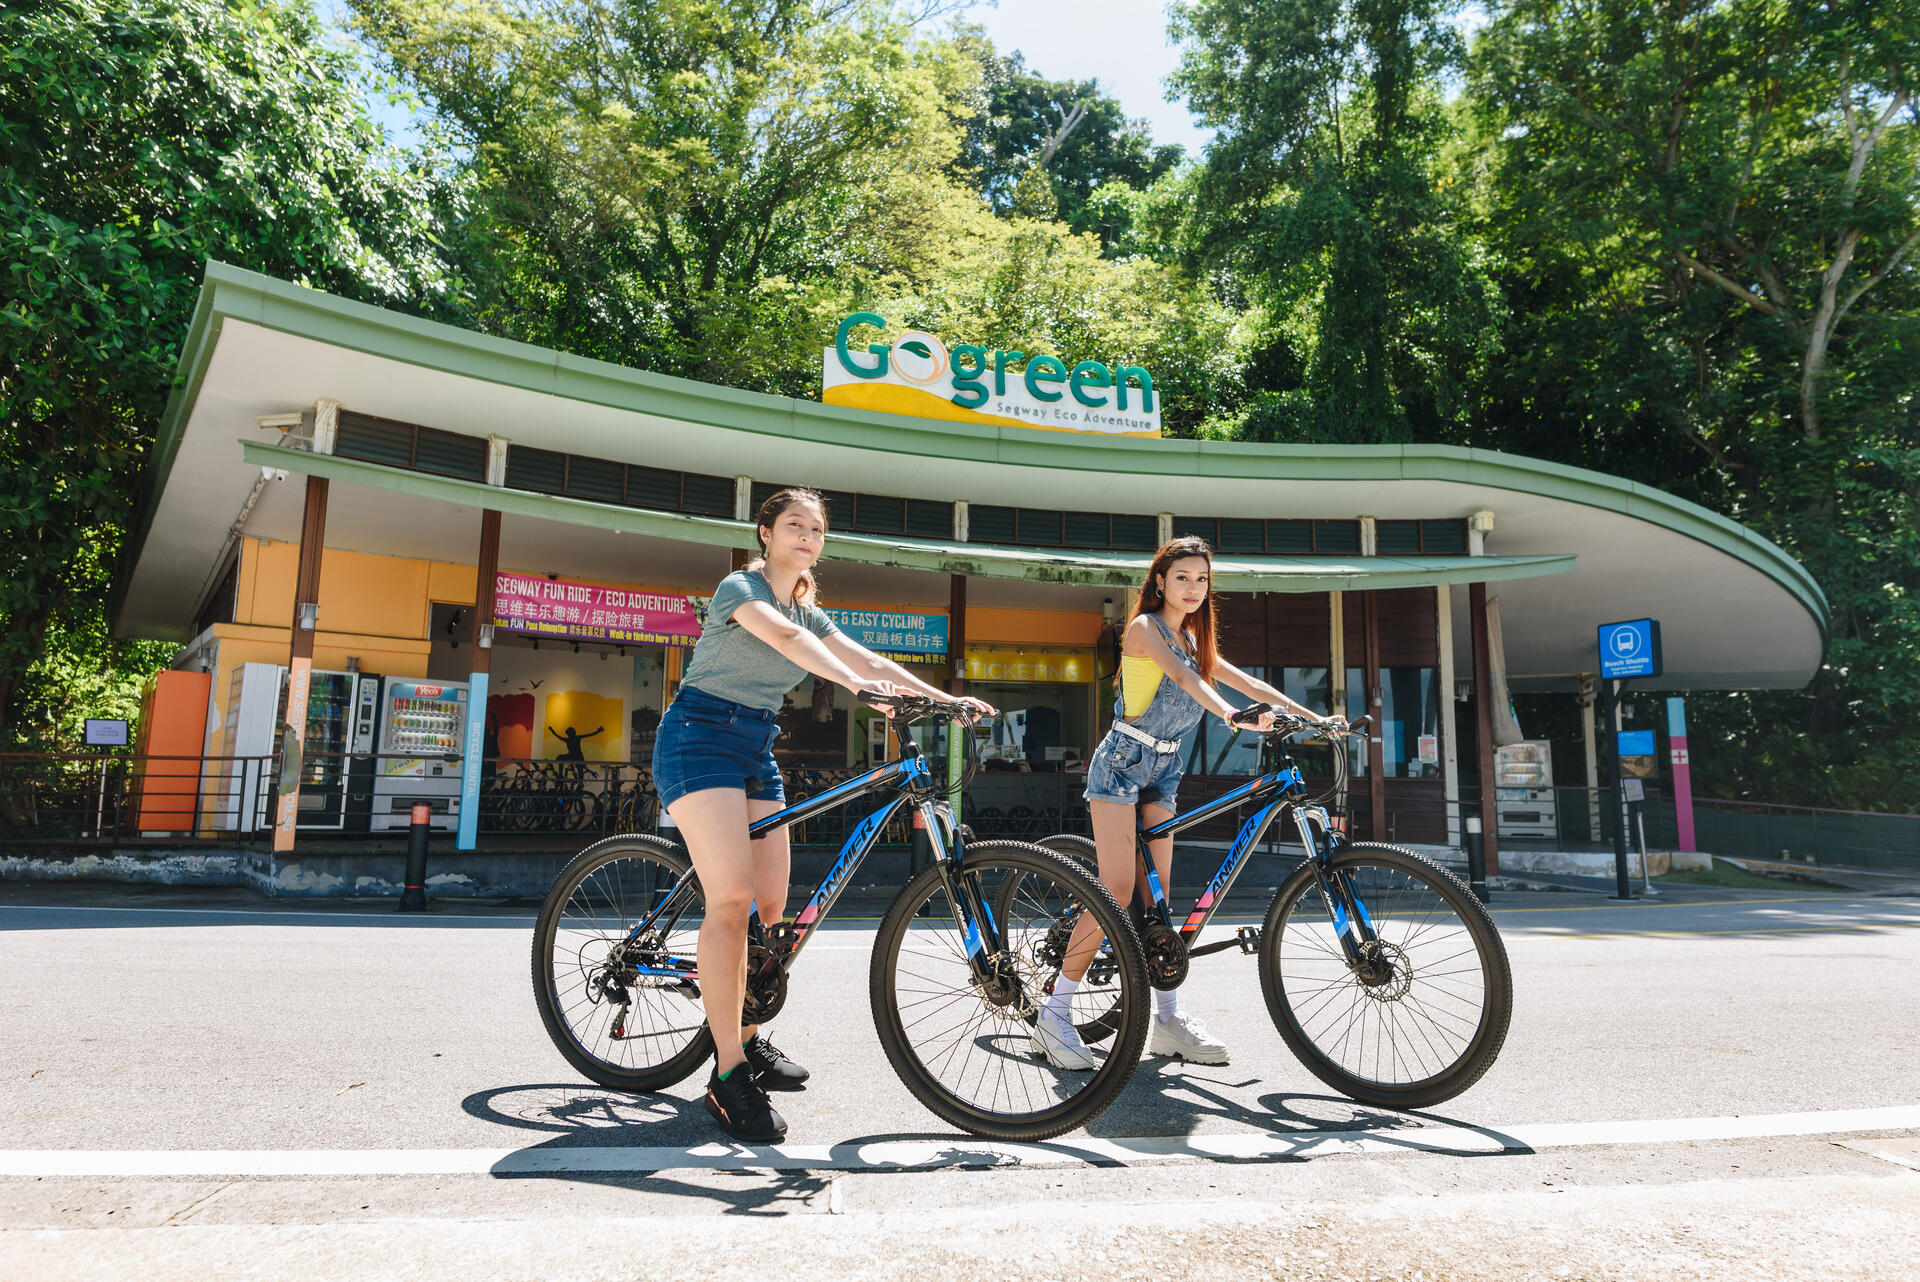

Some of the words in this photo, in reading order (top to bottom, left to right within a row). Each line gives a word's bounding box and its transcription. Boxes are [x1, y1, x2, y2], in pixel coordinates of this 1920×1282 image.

[996, 402, 1047, 419] Segway
[1054, 409, 1078, 421] Eco
[1084, 411, 1152, 429] Adventure
[496, 576, 541, 598] SEGWAY
[544, 582, 565, 600] FUN
[567, 586, 592, 603] RIDE
[596, 590, 603, 604] /
[605, 590, 625, 607] ECO
[628, 593, 686, 614] ADVENTURE
[494, 598, 580, 624] 思维车乐趣游
[591, 608, 645, 630] 探险旅程
[510, 617, 524, 629] FUN
[825, 610, 838, 625] EE
[841, 611, 849, 625] &
[851, 612, 879, 627] EASY
[881, 614, 925, 630] CYCLING
[862, 631, 944, 648] 双踏板自行车
[969, 662, 1078, 681] TICKETING
[470, 721, 481, 761] BICYCLE
[467, 763, 479, 799] RENTAL
[817, 817, 875, 913] ANMIER
[1212, 817, 1258, 898] ANMIER
